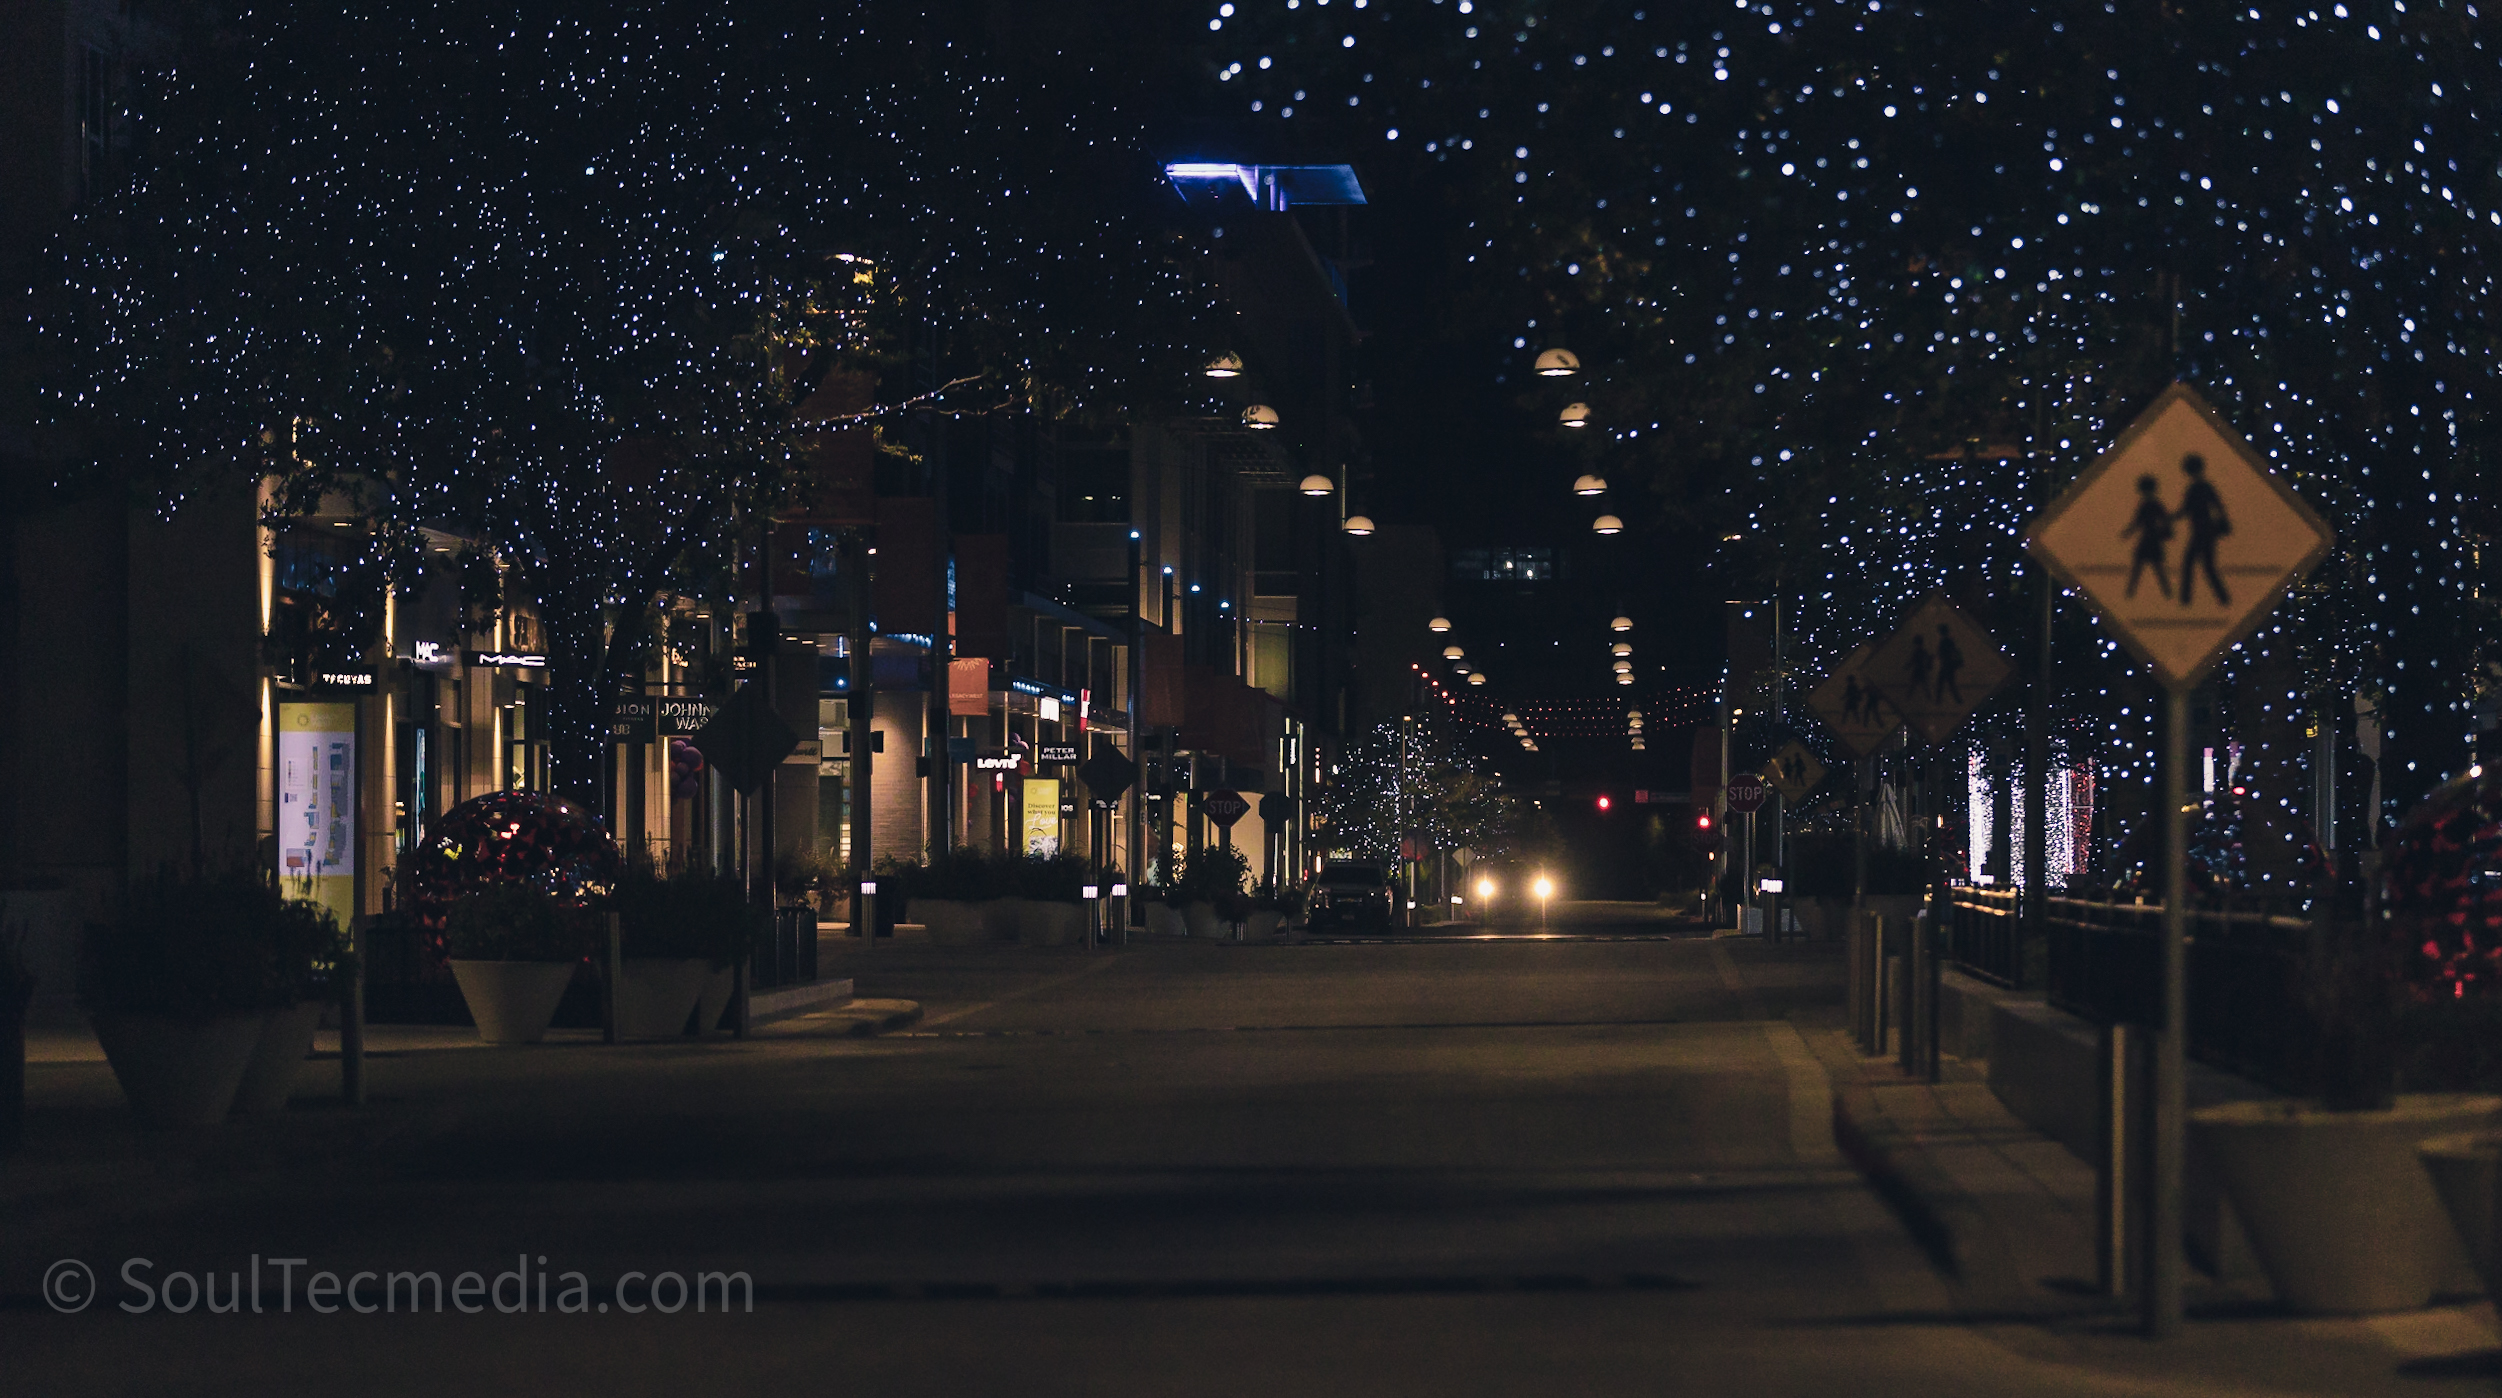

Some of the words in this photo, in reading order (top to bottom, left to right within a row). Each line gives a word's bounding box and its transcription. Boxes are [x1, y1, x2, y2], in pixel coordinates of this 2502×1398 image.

[1040, 753, 1078, 761] MILLAR
[1728, 786, 1763, 801] STOP
[1208, 800, 1241, 815] STOP
